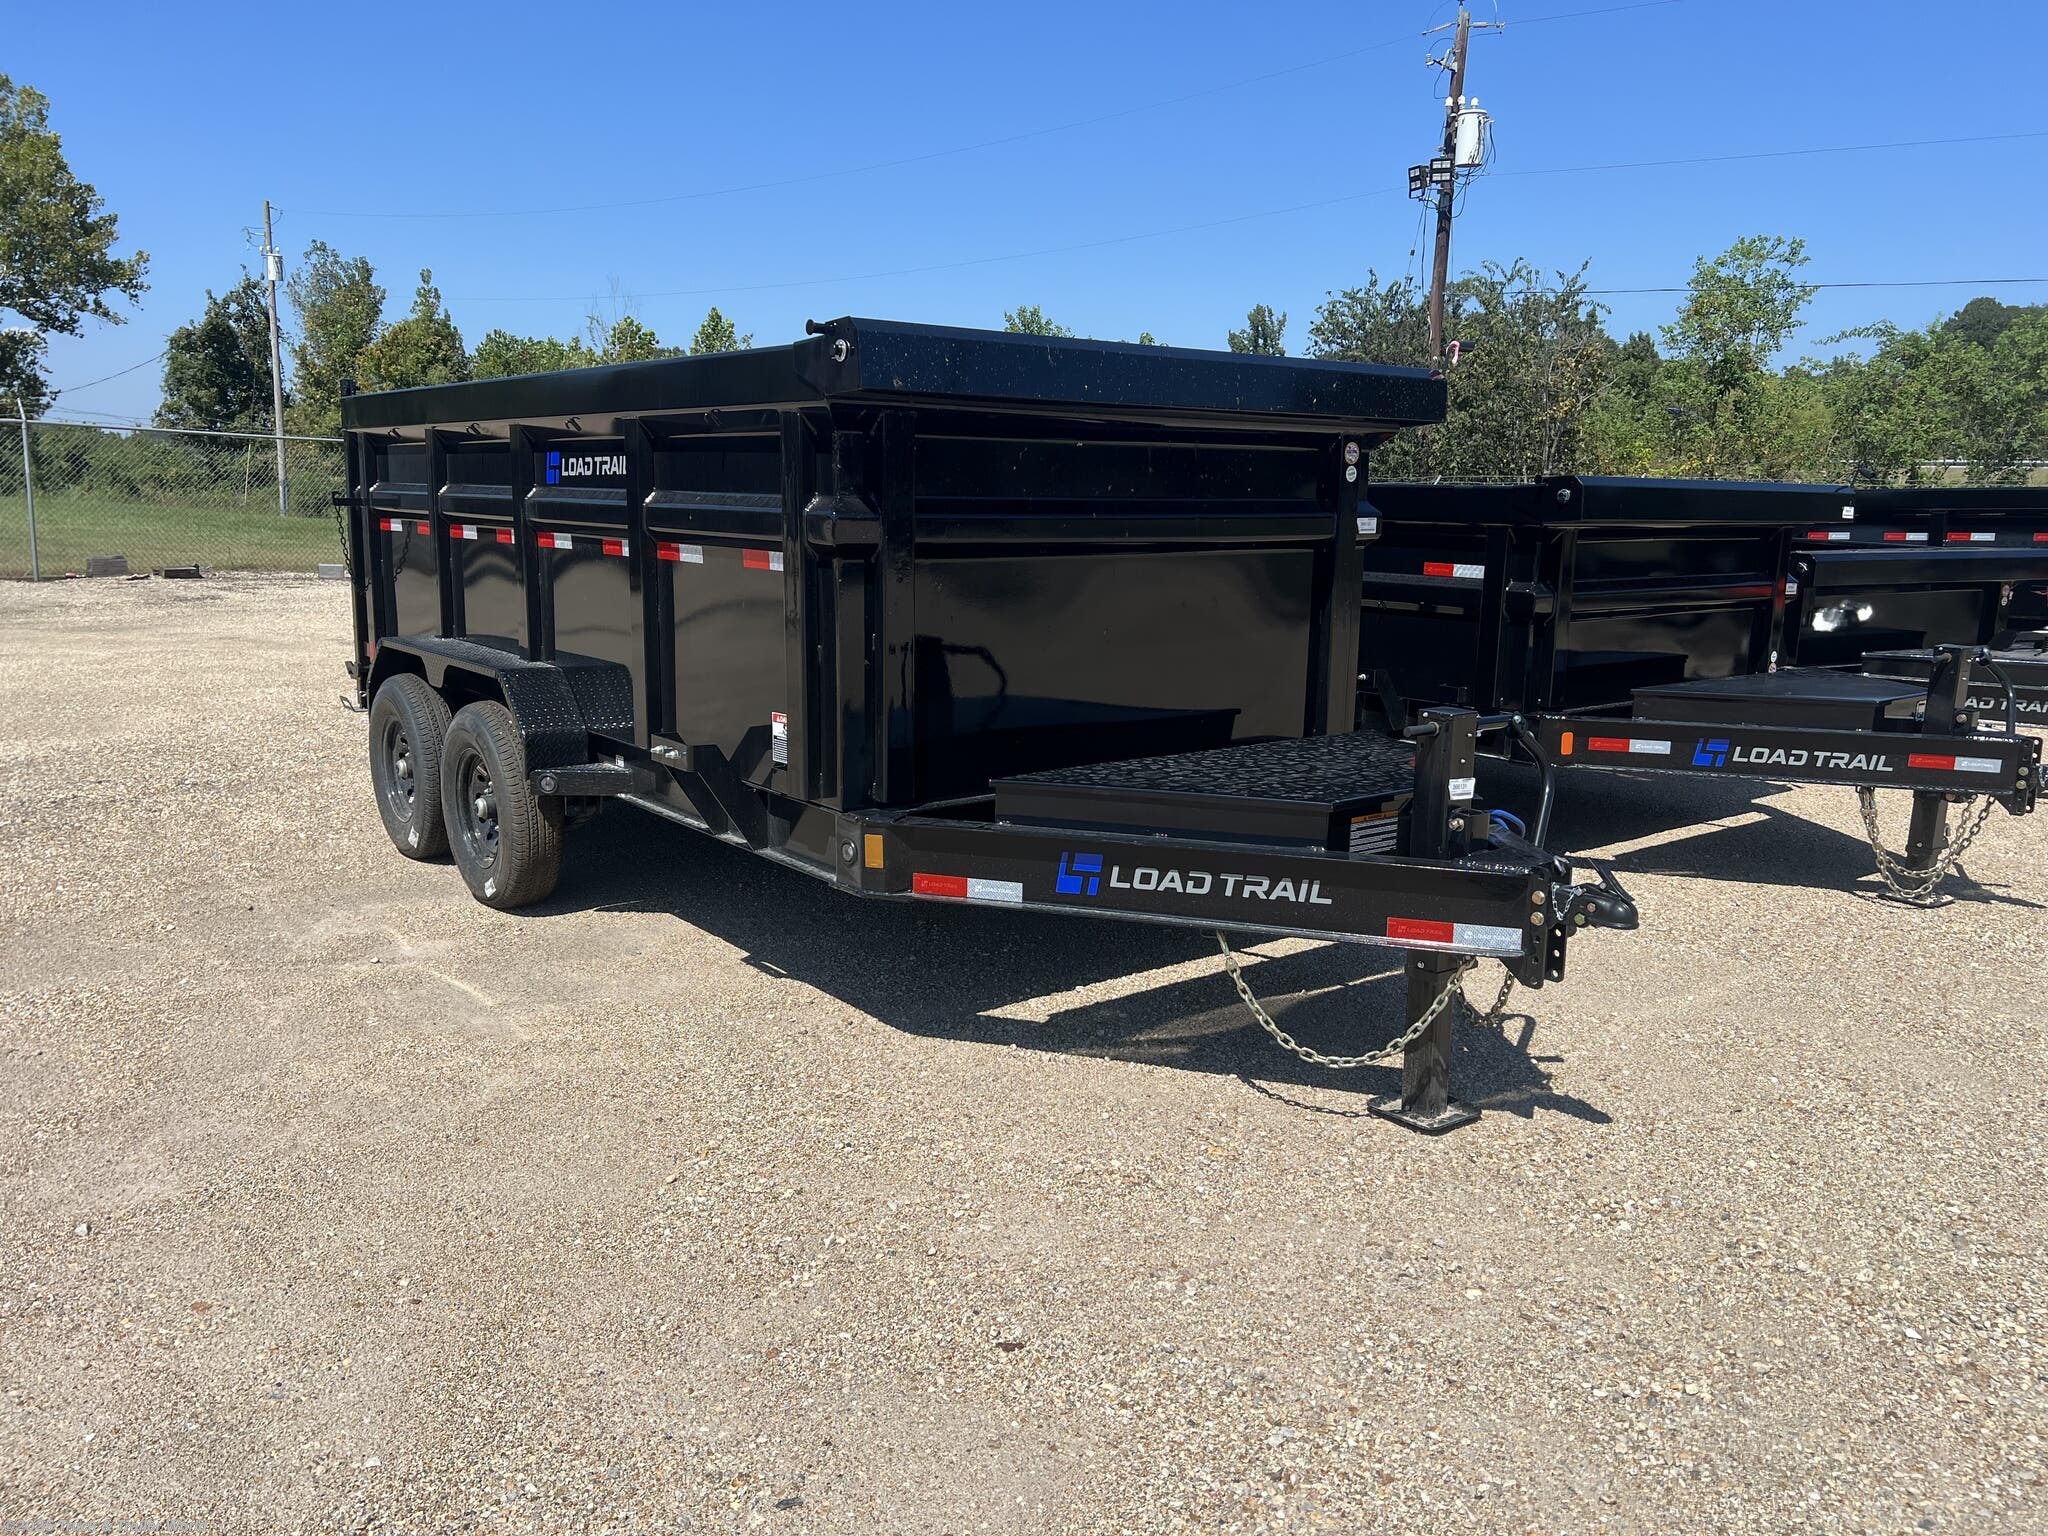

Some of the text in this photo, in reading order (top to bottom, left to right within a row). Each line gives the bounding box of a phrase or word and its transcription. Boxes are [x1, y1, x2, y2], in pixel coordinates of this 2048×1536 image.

[561, 457, 593, 476] LOAD
[1963, 696, 1995, 709] AD
[1732, 746, 1809, 766] LOAD
[1813, 751, 1894, 772] TRAIL
[1109, 865, 1213, 895] LOAD
[1219, 873, 1333, 905] TRAIL
